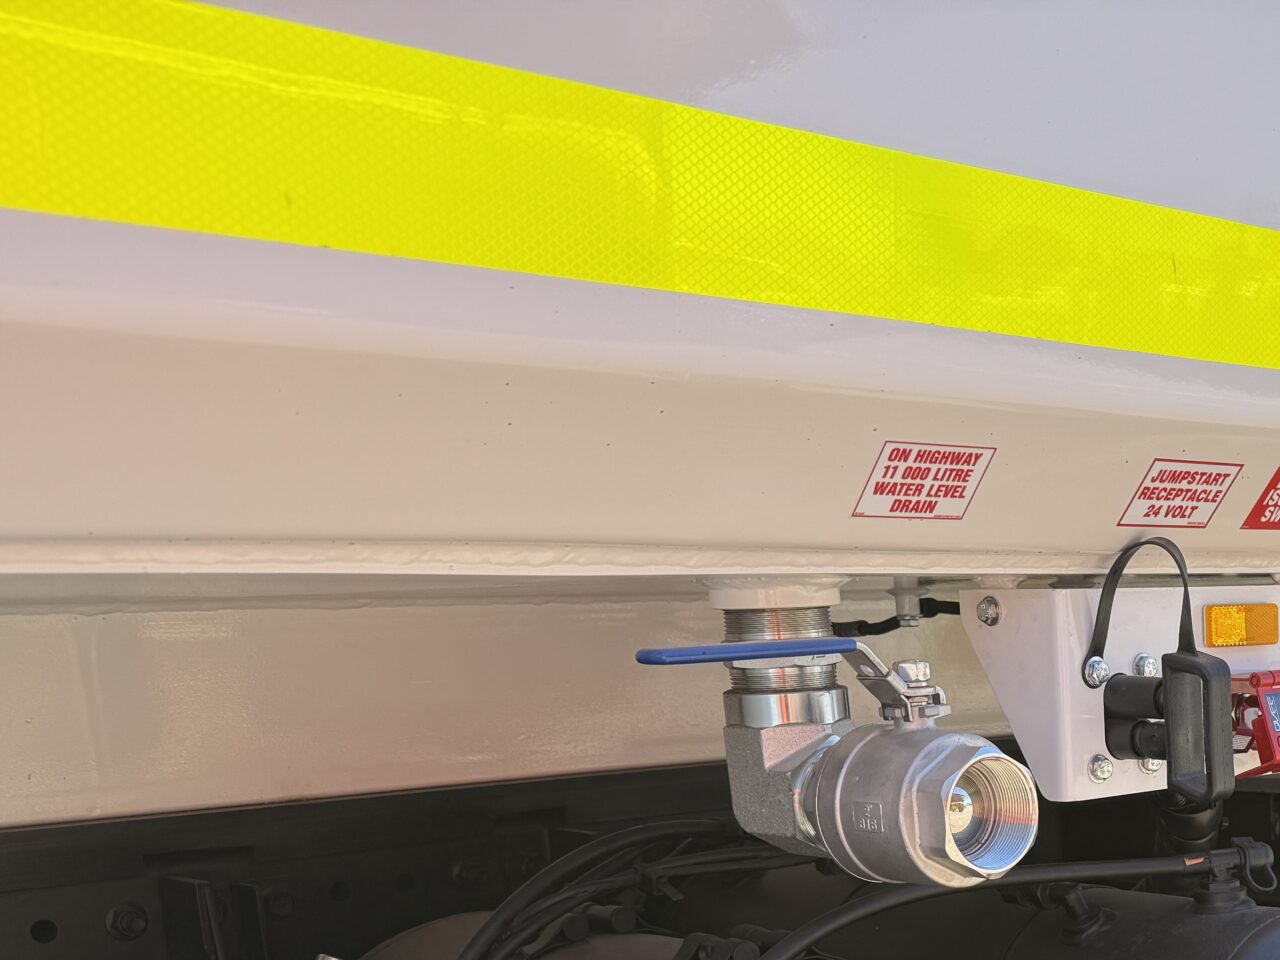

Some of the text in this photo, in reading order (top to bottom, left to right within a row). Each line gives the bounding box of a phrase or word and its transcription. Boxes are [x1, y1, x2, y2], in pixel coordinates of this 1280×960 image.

[887, 447, 983, 466] ON HIGHWAY
[882, 464, 974, 483] 11 000 LITRE
[1151, 469, 1231, 486] JUMPSTART
[873, 481, 967, 498] WATER LEVEL
[1138, 486, 1223, 503] RECEPTACLE
[889, 498, 938, 513] DRAIN
[1143, 504, 1199, 519] 24 VOLT
